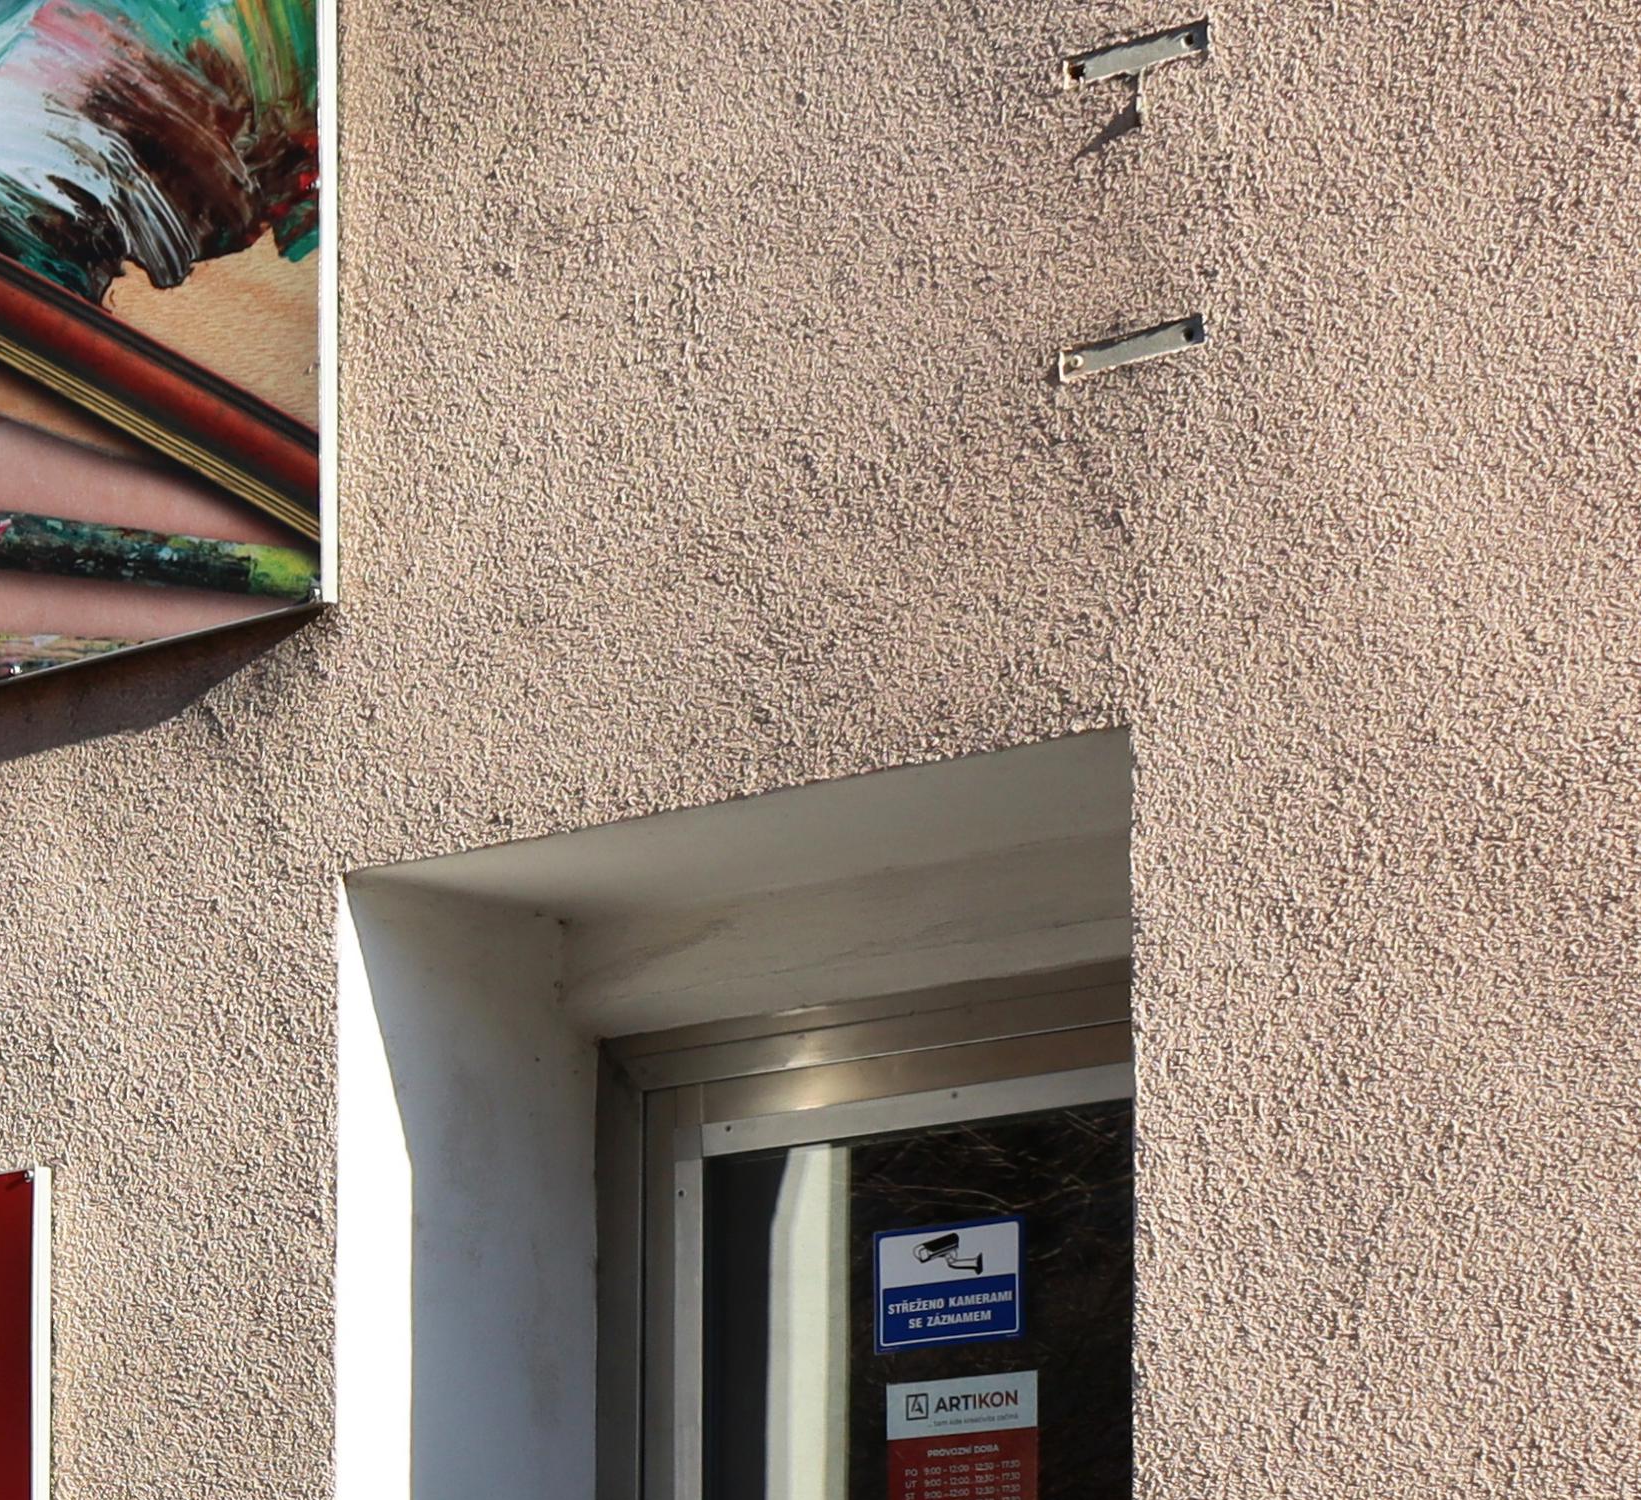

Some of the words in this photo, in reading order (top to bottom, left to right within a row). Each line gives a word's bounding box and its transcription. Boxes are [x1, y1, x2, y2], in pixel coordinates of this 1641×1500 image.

[887, 1297, 945, 1315] STŘEŽENO
[948, 1290, 1013, 1308] KAMERAMI
[908, 1317, 923, 1329] SE
[926, 1309, 992, 1327] ZÁZNAMEM
[934, 1389, 1019, 1414] ARTIKON
